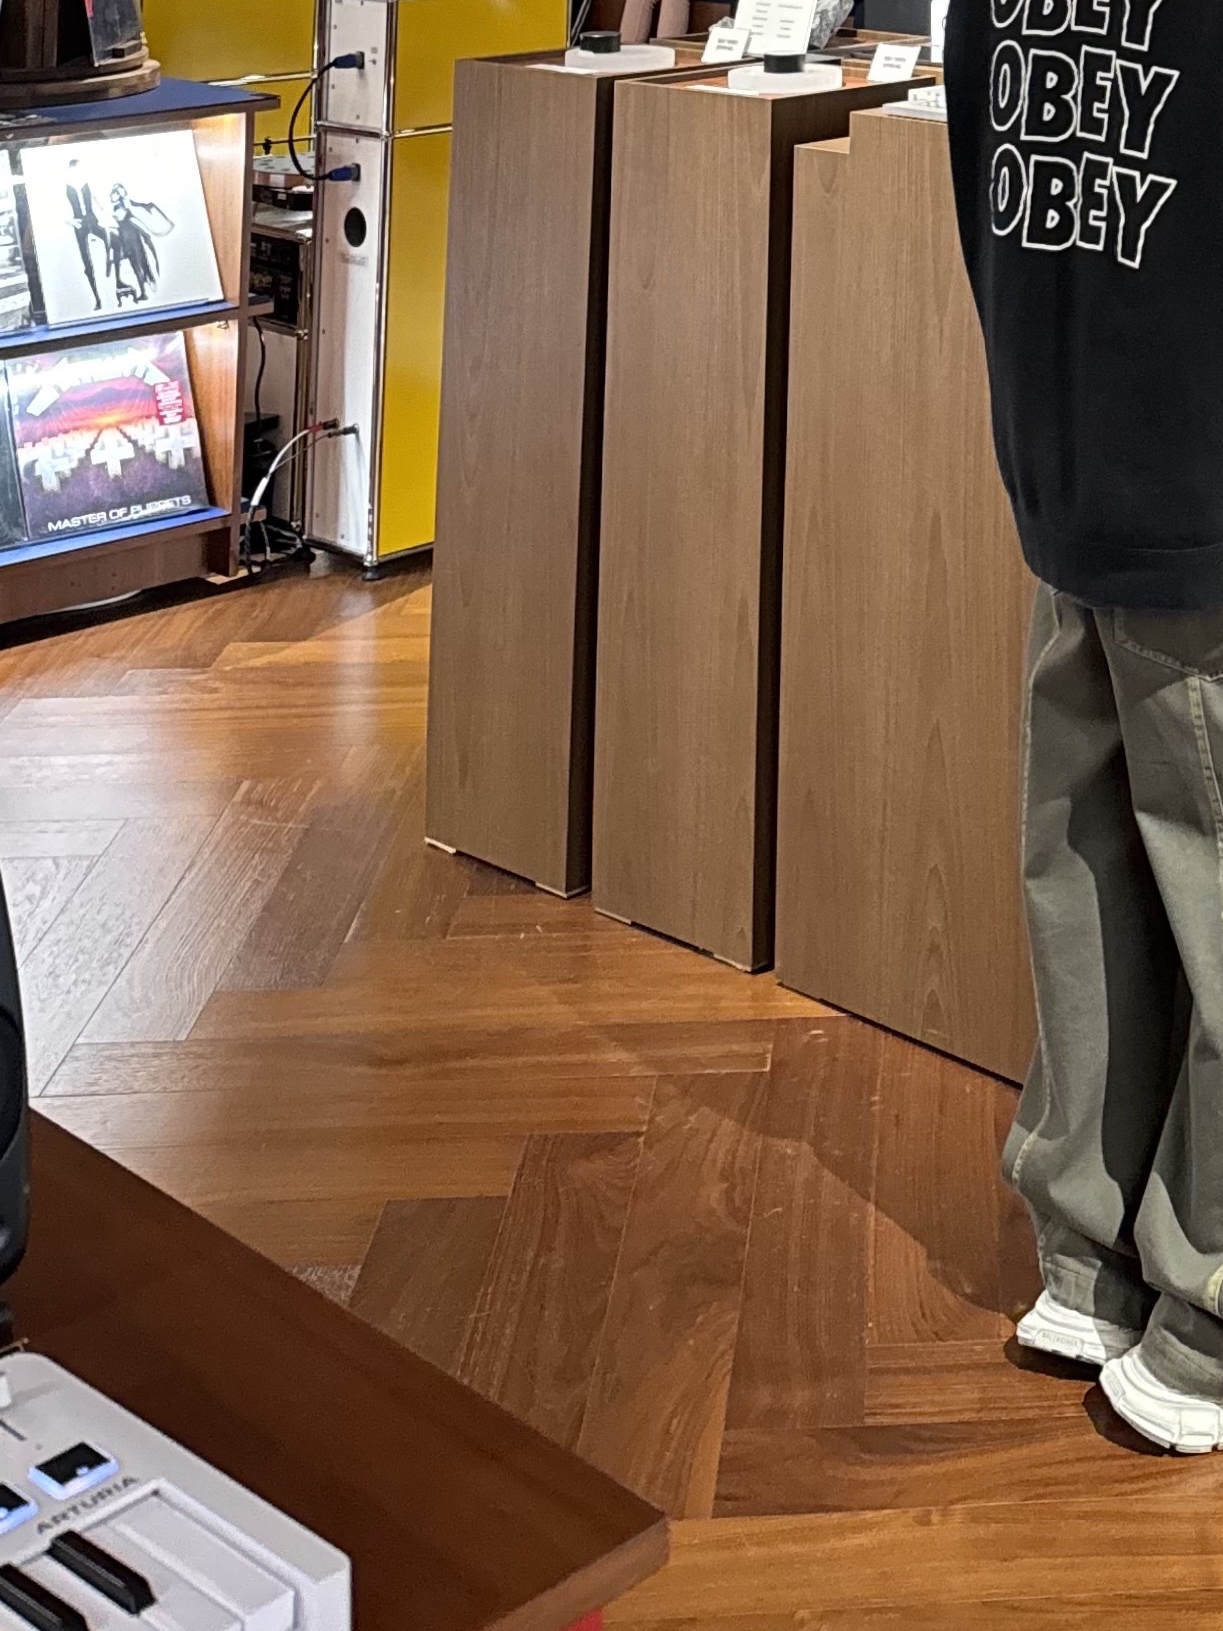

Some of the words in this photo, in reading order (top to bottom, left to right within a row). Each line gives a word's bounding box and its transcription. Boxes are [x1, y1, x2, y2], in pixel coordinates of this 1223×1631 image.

[989, 39, 1181, 160] OBEY
[989, 142, 1178, 269] OBEY
[47, 511, 107, 532] MASTER
[109, 506, 129, 520] OF
[36, 1475, 140, 1536] ARTURIA
